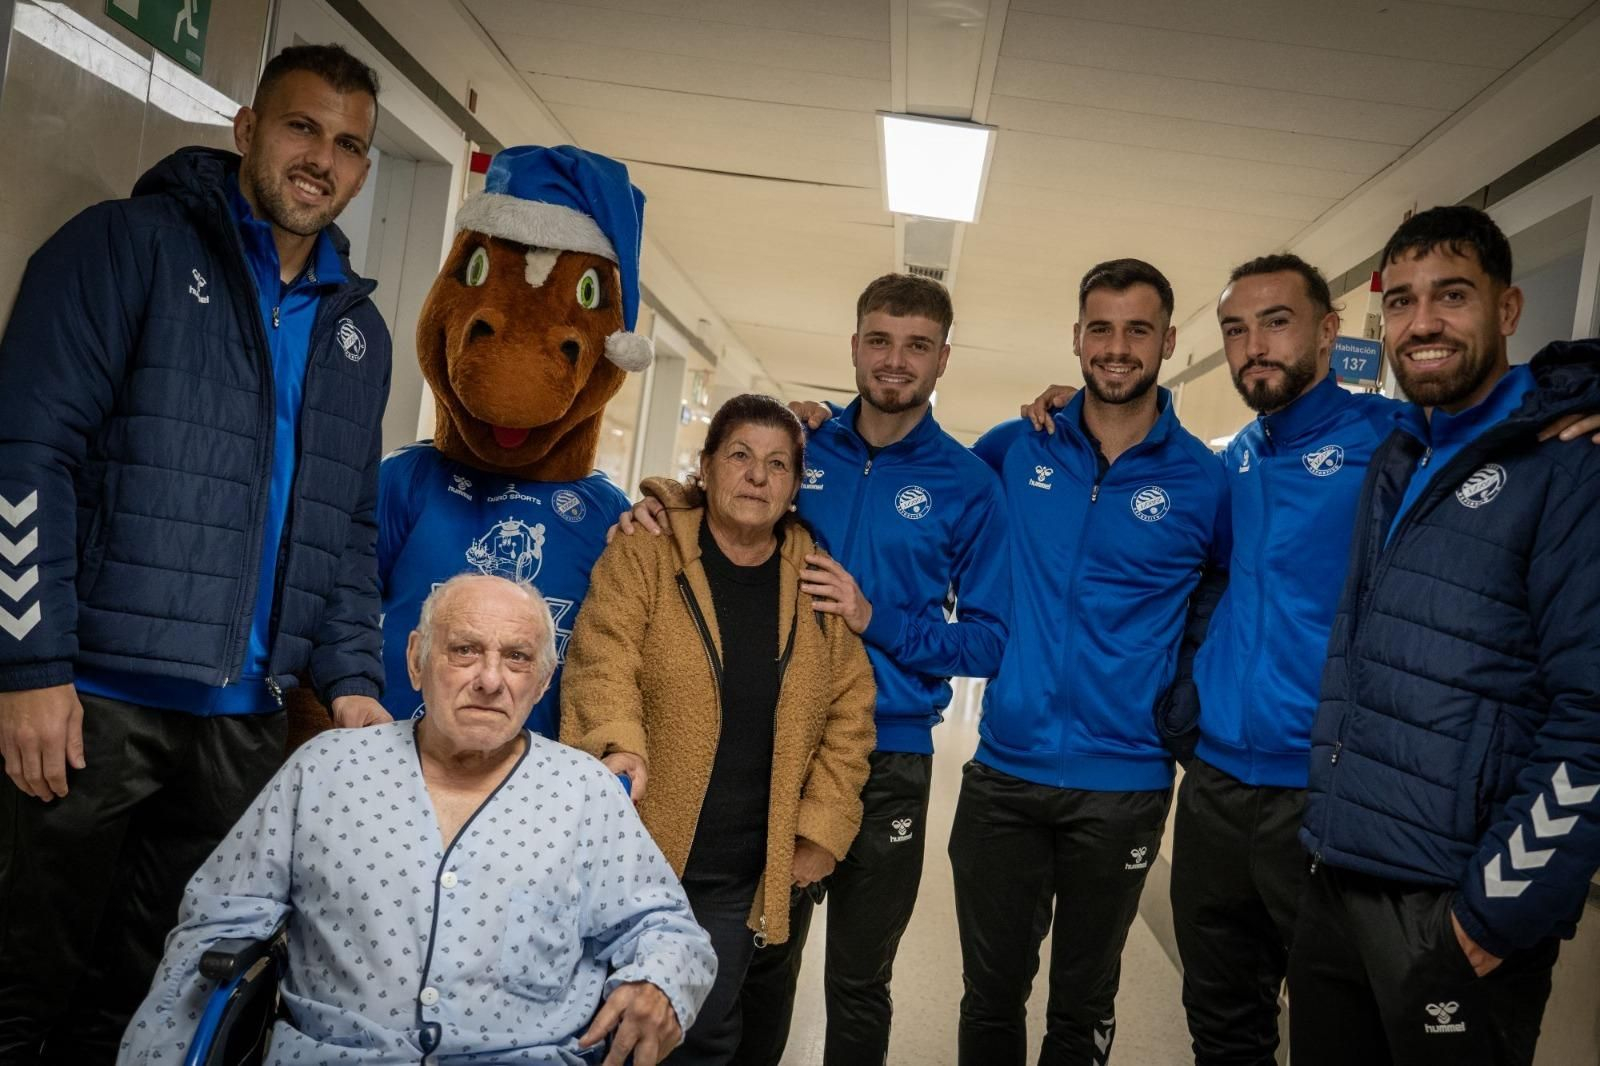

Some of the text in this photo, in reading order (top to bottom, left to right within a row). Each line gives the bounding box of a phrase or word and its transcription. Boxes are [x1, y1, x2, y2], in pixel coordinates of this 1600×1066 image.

[1335, 342, 1377, 355] Habitación
[1342, 356, 1367, 372] 137
[509, 493, 542, 505] SPORTS
[1424, 1021, 1466, 1033] hummel
